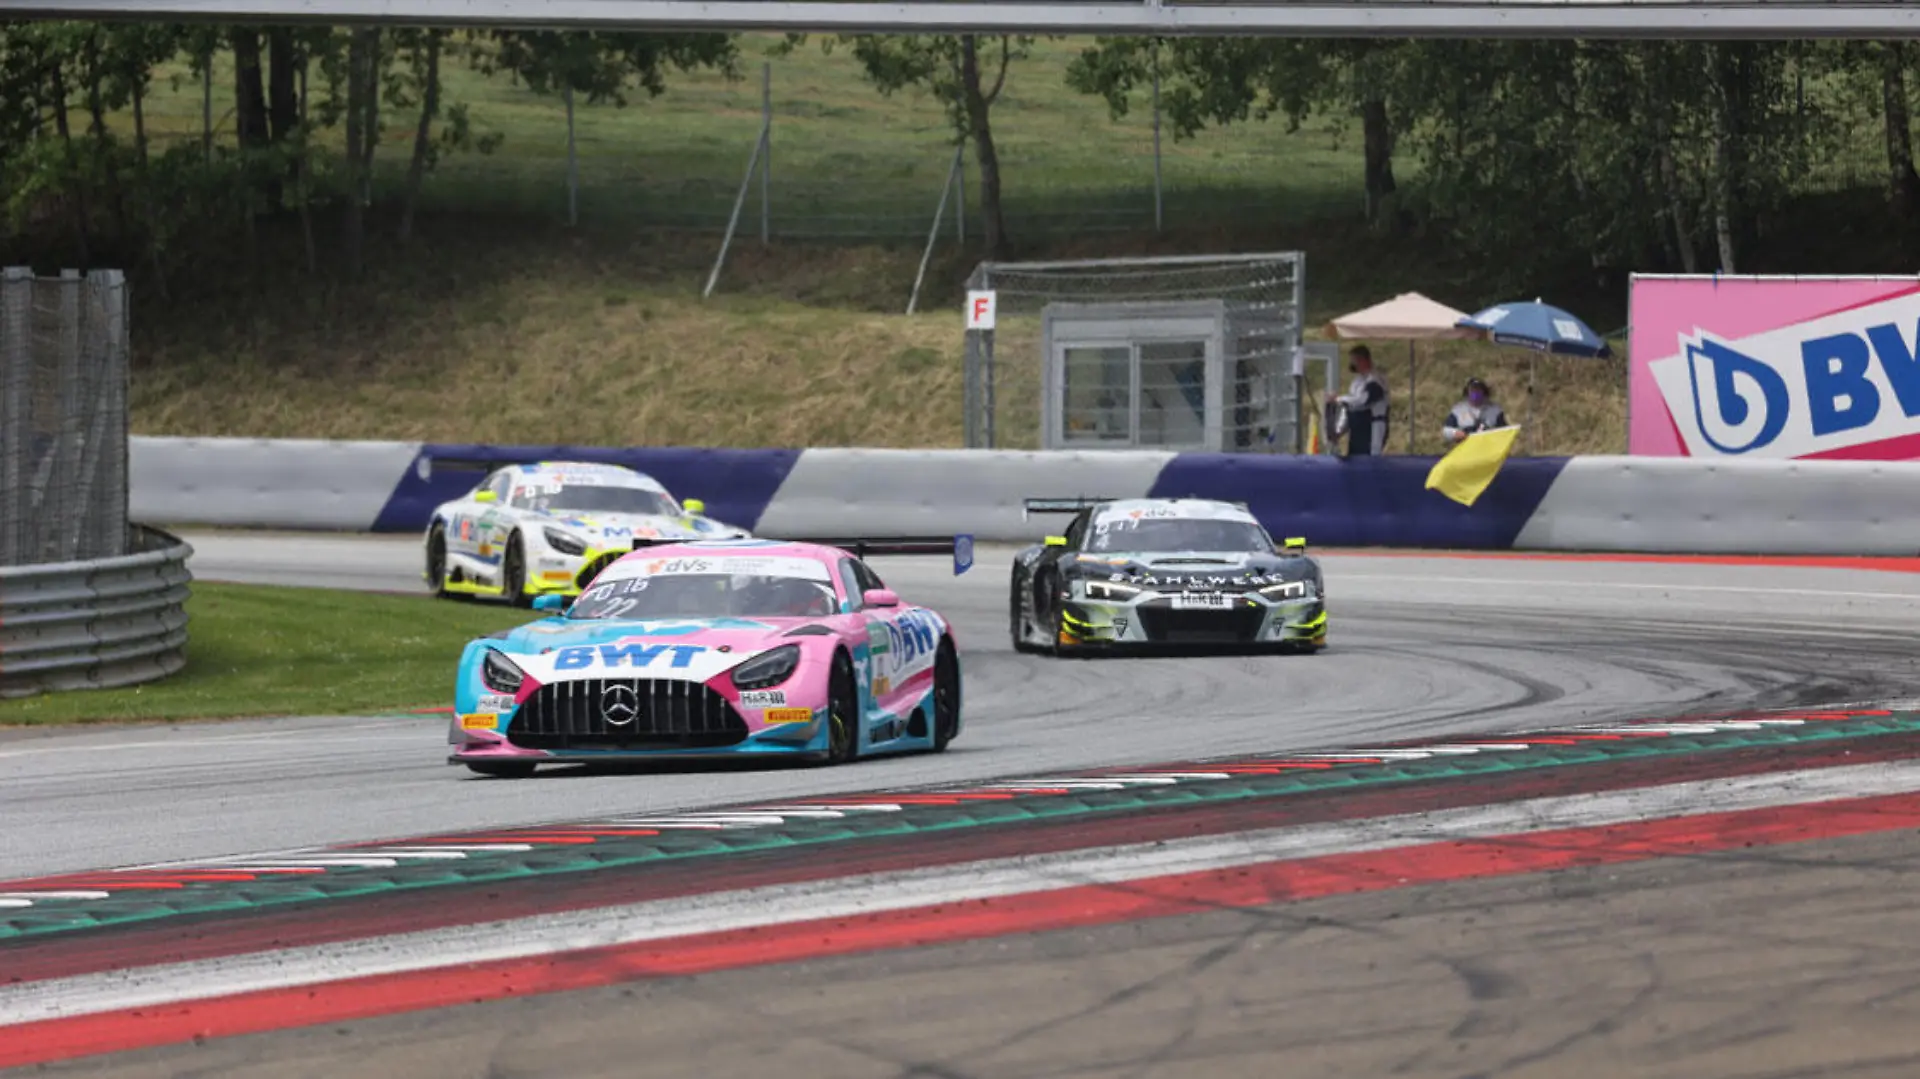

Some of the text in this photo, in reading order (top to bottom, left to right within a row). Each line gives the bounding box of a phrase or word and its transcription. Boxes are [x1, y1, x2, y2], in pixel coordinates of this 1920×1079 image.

[974, 297, 989, 322] F
[665, 559, 708, 573] dvs
[1108, 572, 1284, 586] STAHLWERK
[553, 643, 707, 671] BWT
